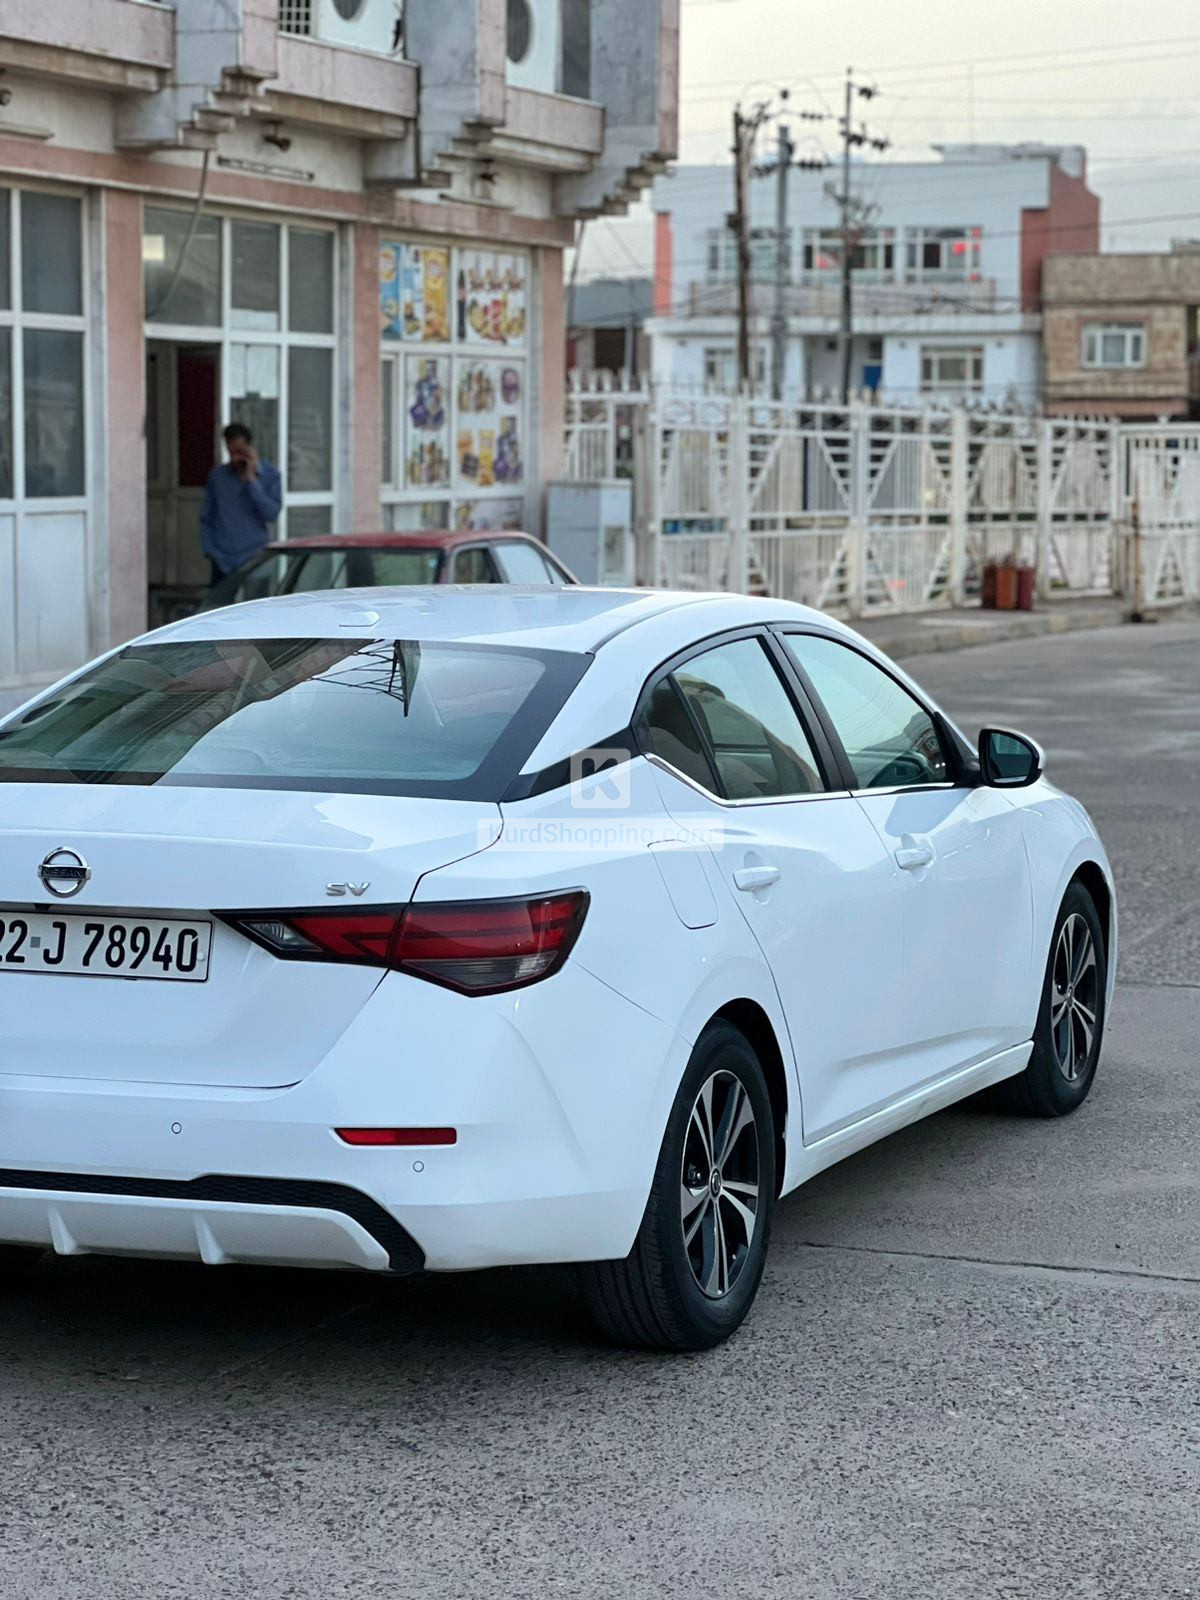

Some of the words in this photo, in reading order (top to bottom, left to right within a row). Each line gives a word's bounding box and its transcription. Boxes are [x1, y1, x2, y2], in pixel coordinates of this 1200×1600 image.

[43, 868, 84, 878] NISSAN
[325, 882, 371, 897] SV
[0, 919, 28, 963] 2
[43, 921, 67, 965] J
[82, 923, 199, 972] 78940
